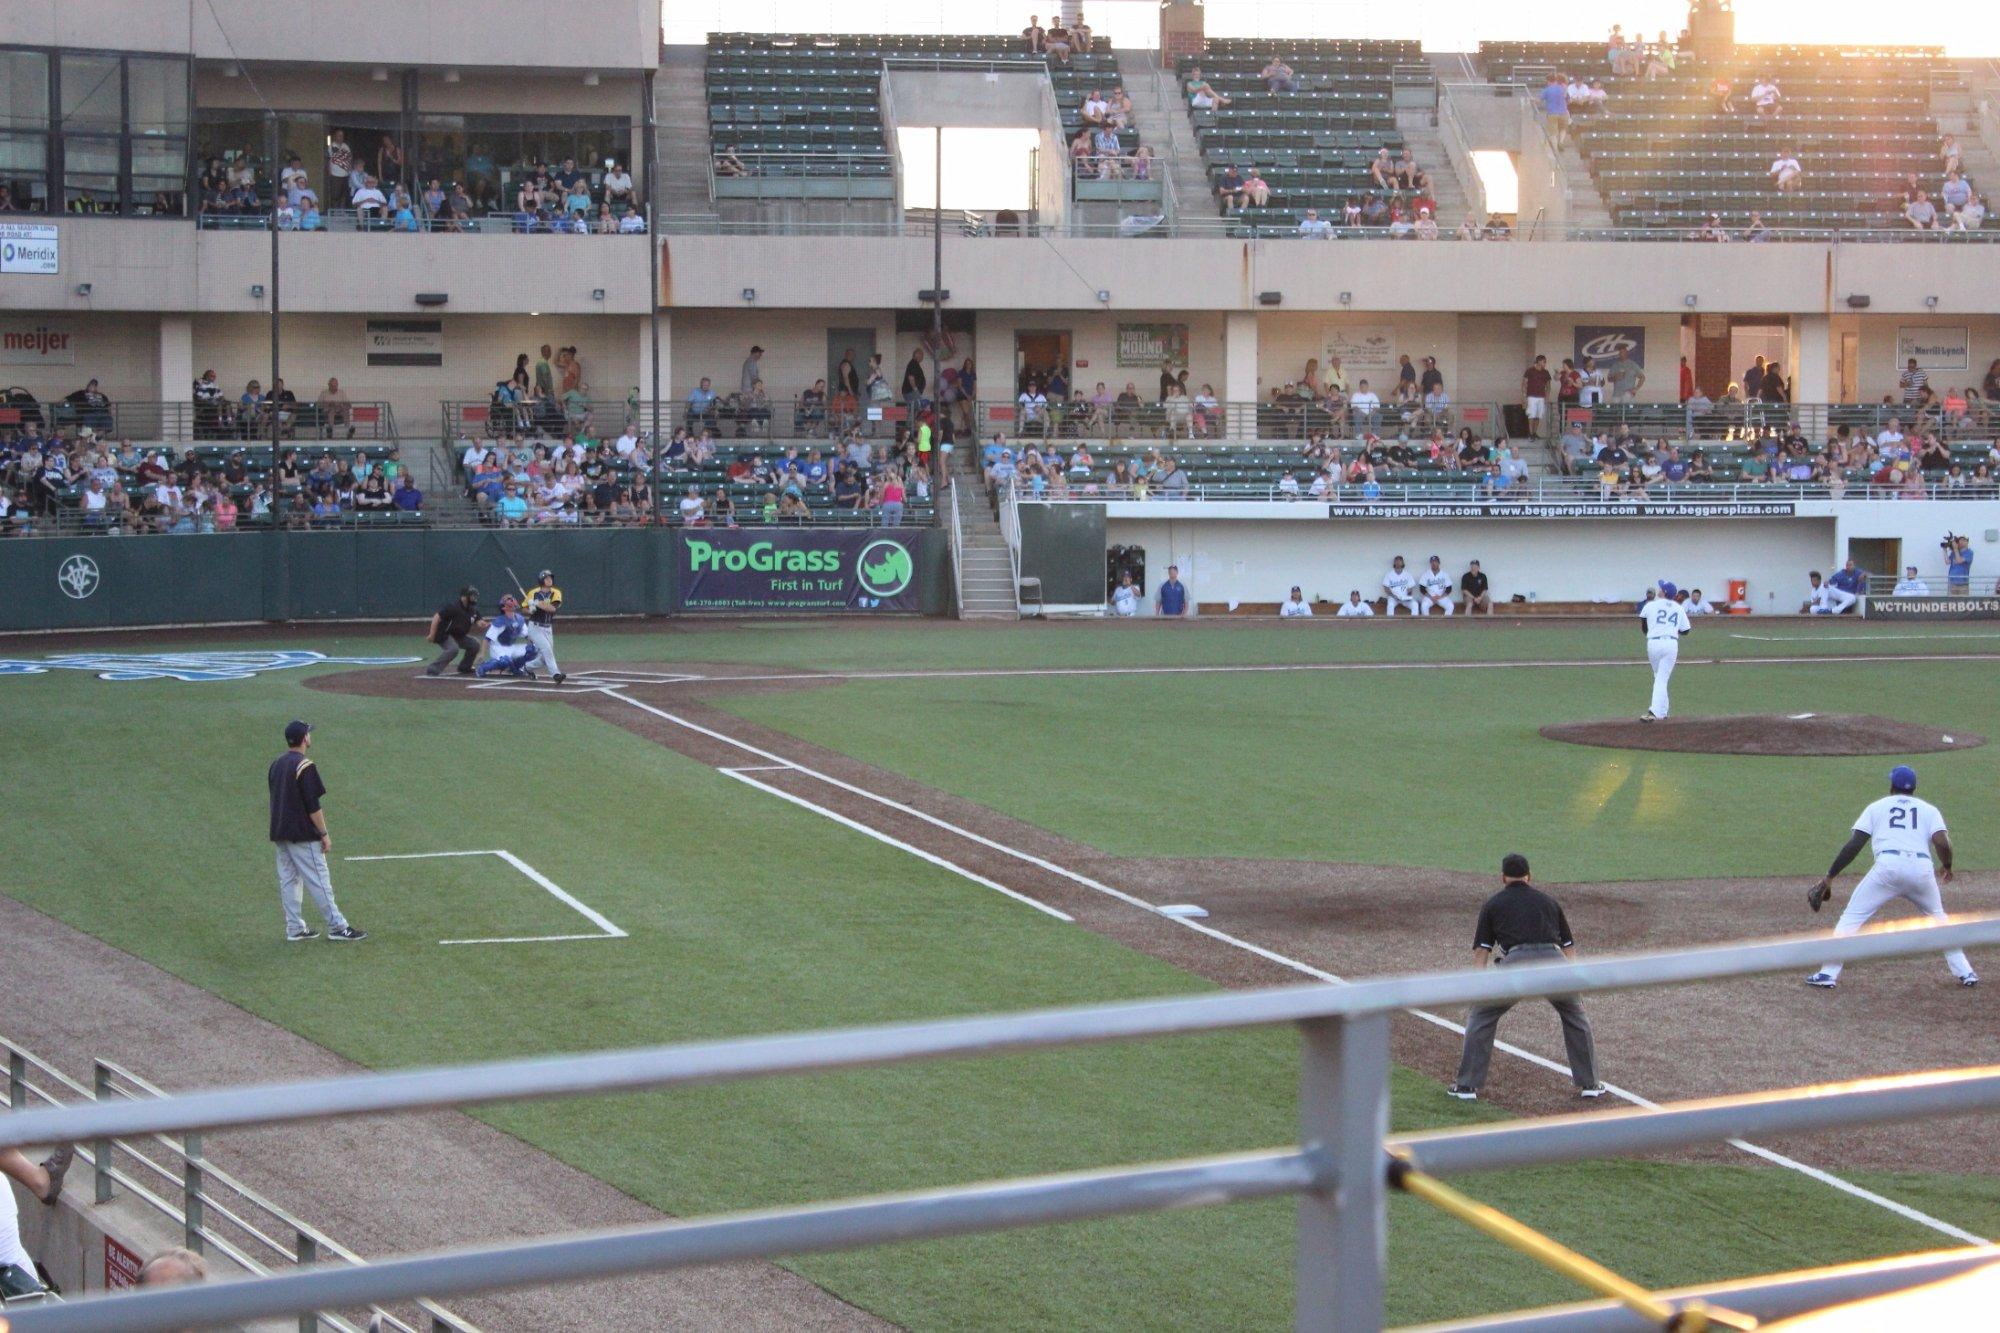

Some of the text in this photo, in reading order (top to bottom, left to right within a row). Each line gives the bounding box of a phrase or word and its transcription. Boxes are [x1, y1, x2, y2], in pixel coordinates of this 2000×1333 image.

[17, 246, 56, 260] Meridix
[4, 327, 69, 355] meijer
[1120, 341, 1163, 354] MOUND
[1914, 345, 1966, 357] Merrill Lynch
[1333, 504, 1791, 517] www.beggarspizza.com www.beggarspizza.com www.beggarspizza.com
[685, 537, 840, 572] ProGrass
[771, 579, 843, 591] First in Turf
[1656, 609, 1678, 627] 24
[1889, 806, 1918, 830] 21
